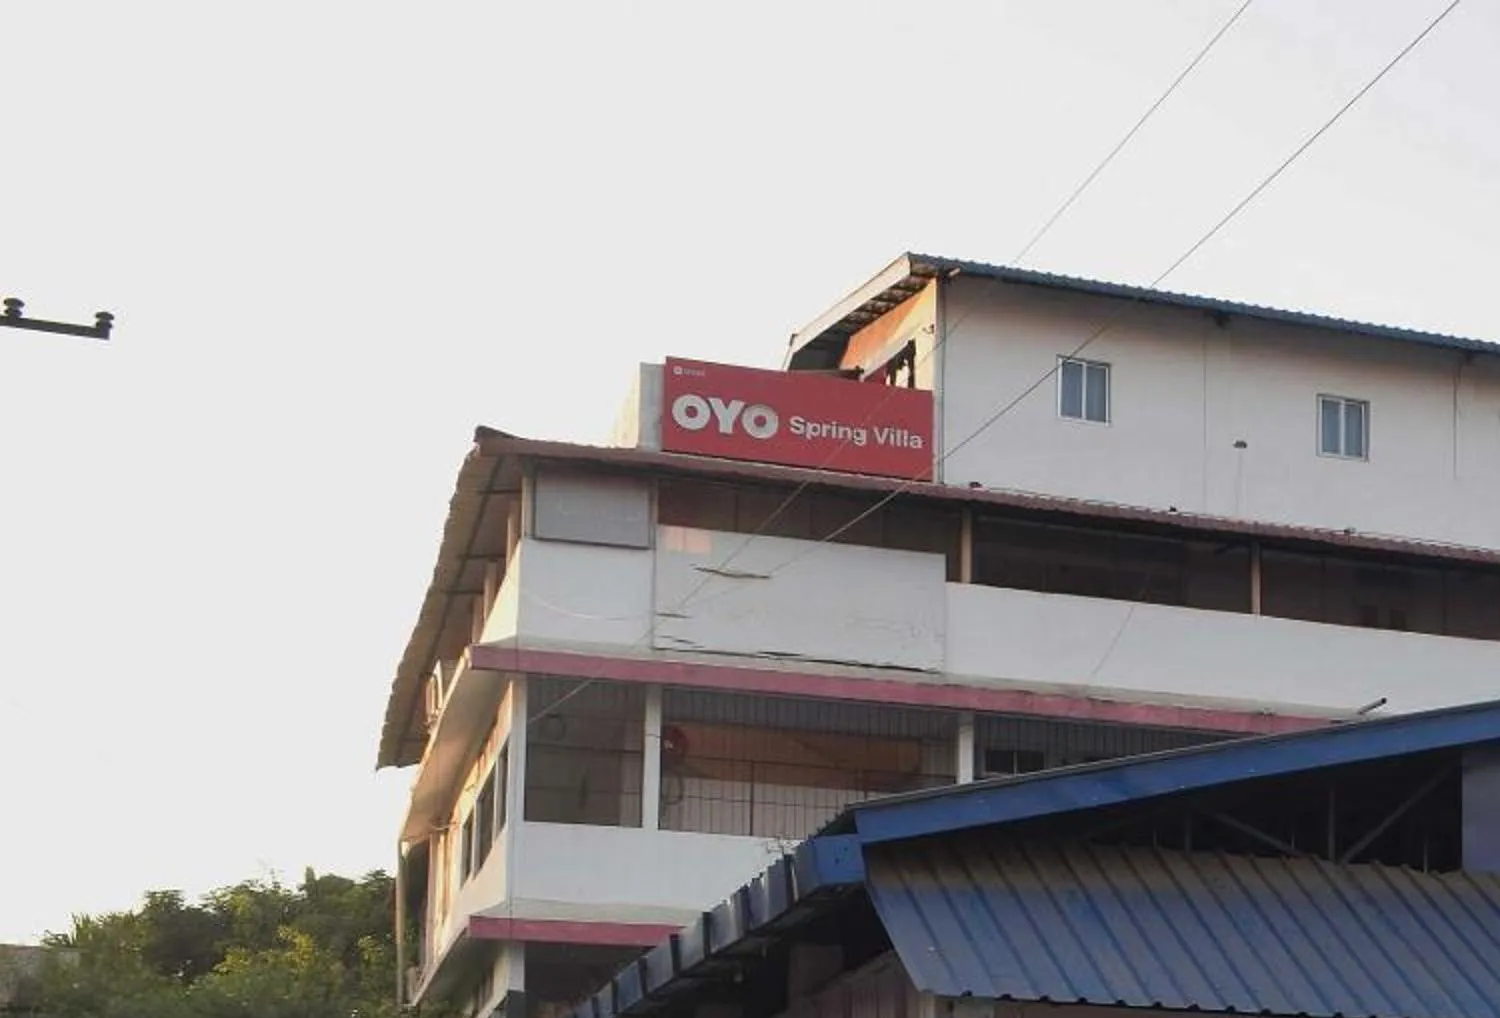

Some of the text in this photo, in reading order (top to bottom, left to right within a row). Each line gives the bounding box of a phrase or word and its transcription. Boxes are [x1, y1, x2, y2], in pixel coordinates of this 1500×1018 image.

[672, 394, 923, 449] OYO Spring Villa
